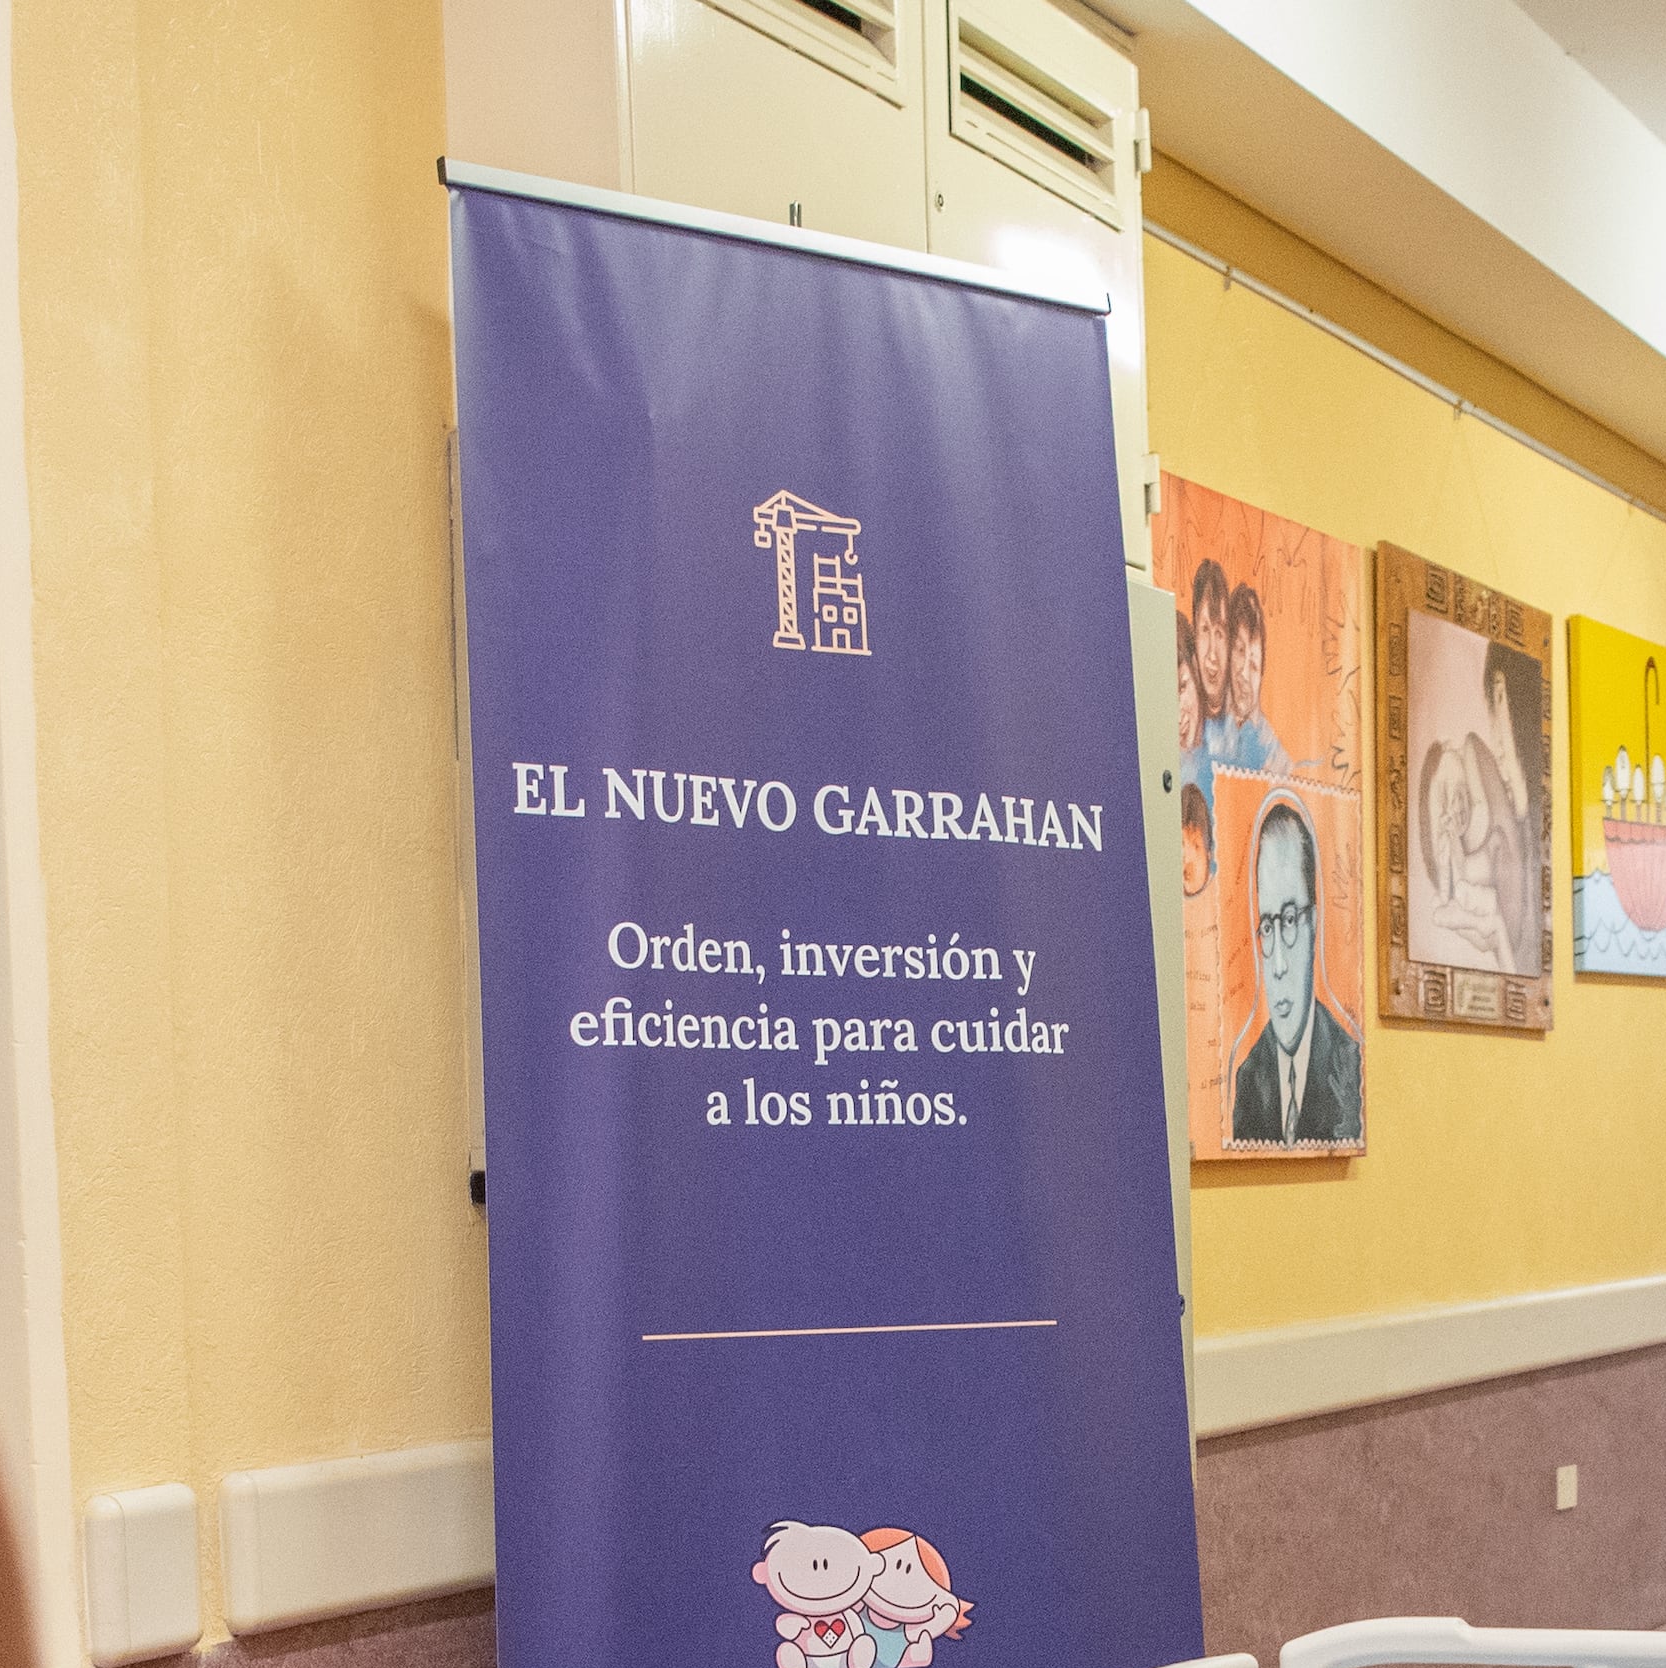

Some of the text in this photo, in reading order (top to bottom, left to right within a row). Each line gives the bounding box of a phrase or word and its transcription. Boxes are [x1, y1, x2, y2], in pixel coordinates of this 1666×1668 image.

[511, 762, 1103, 851] EL NUEVO GARRAHAN
[607, 921, 1036, 996] Orden, inversión y
[569, 997, 1070, 1066] eficiencia para cuidar
[706, 1077, 967, 1126] a los niños.
